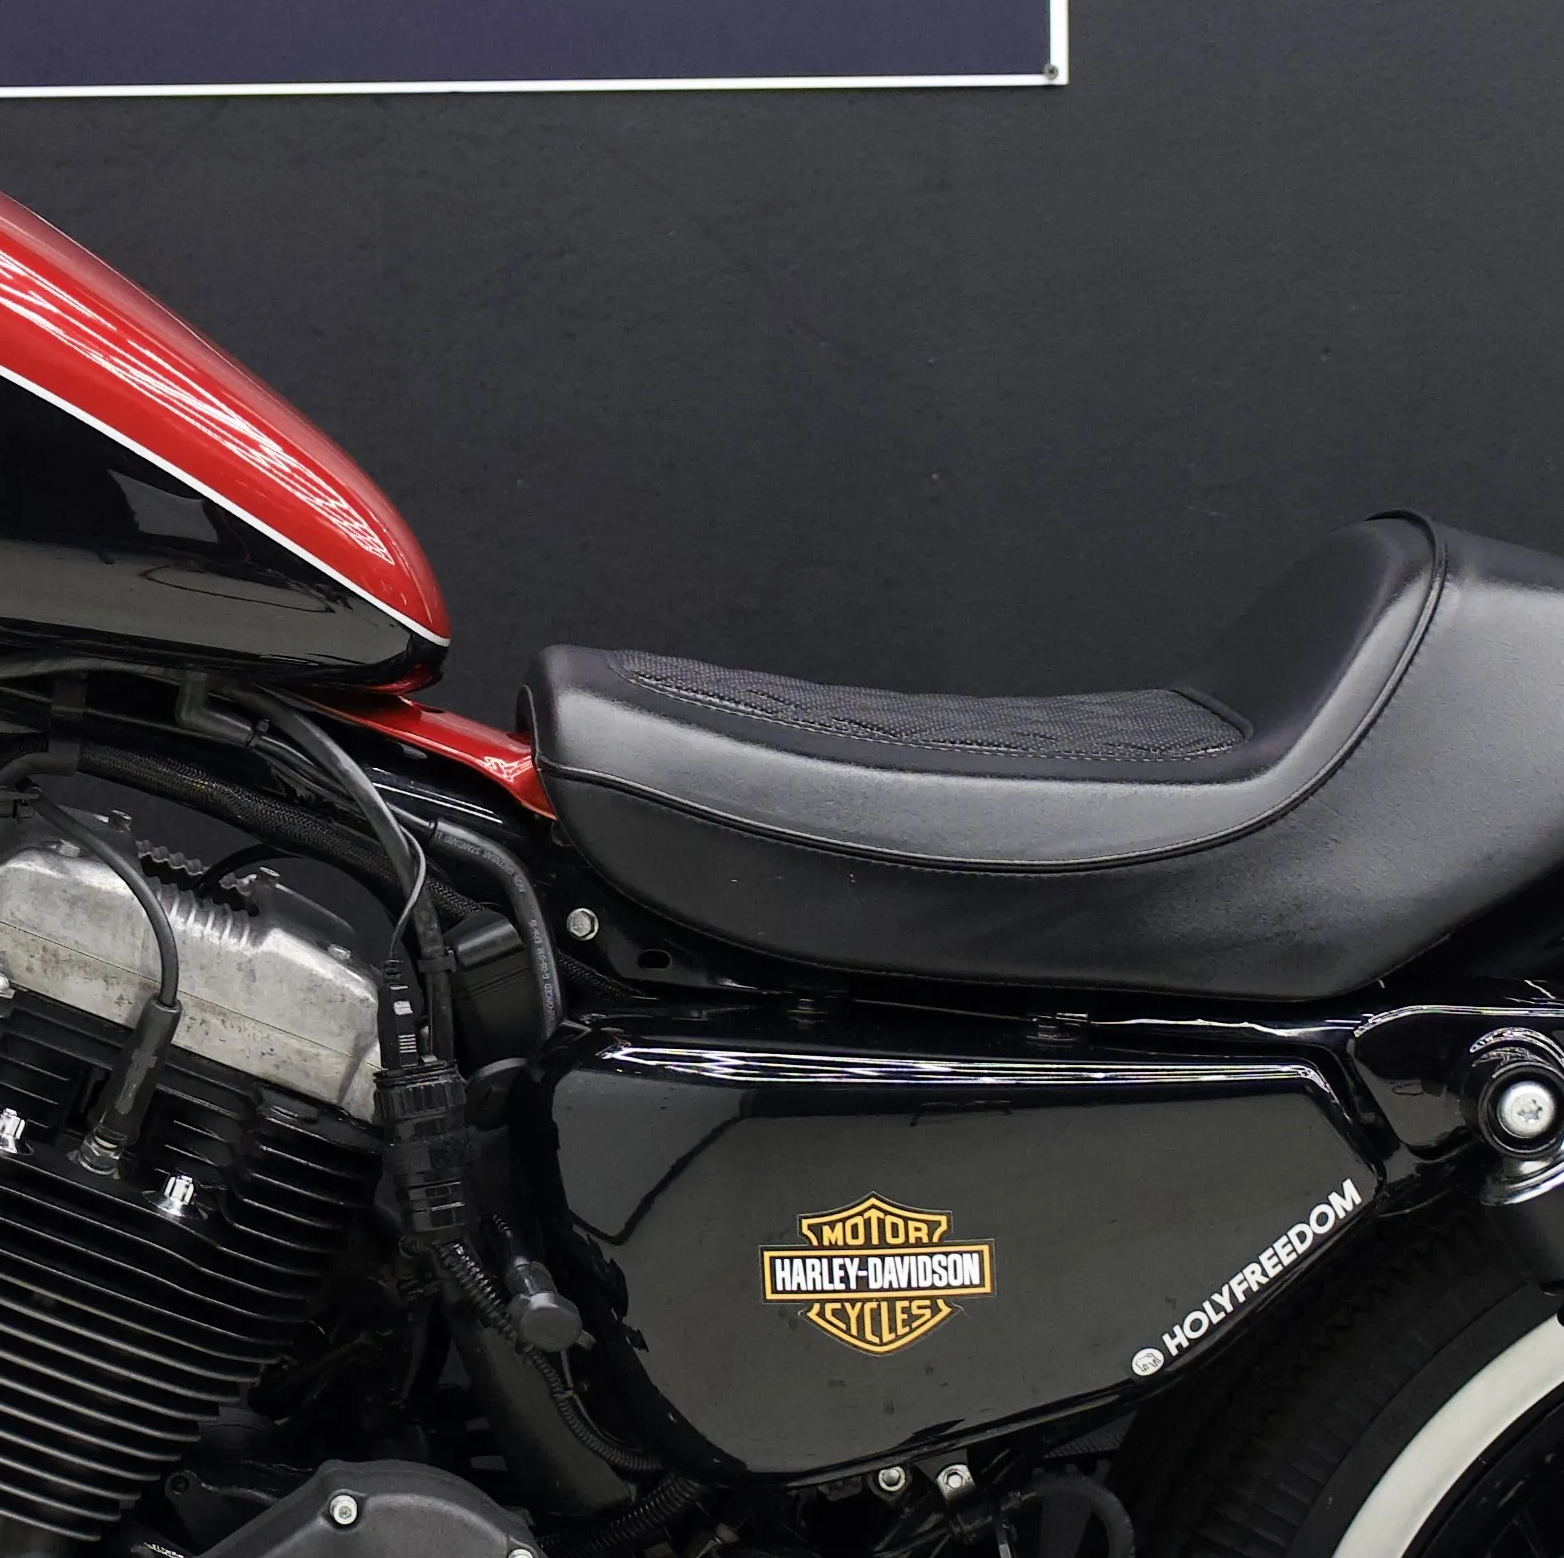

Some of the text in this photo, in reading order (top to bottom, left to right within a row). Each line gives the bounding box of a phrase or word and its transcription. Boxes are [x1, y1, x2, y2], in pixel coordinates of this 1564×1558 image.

[822, 1208, 930, 1246] MOTOR
[775, 1253, 981, 1291] HARLEY-DAVIDSON
[1161, 1178, 1362, 1357] HOLYFREEDOM
[825, 1299, 932, 1344] CYCLES
